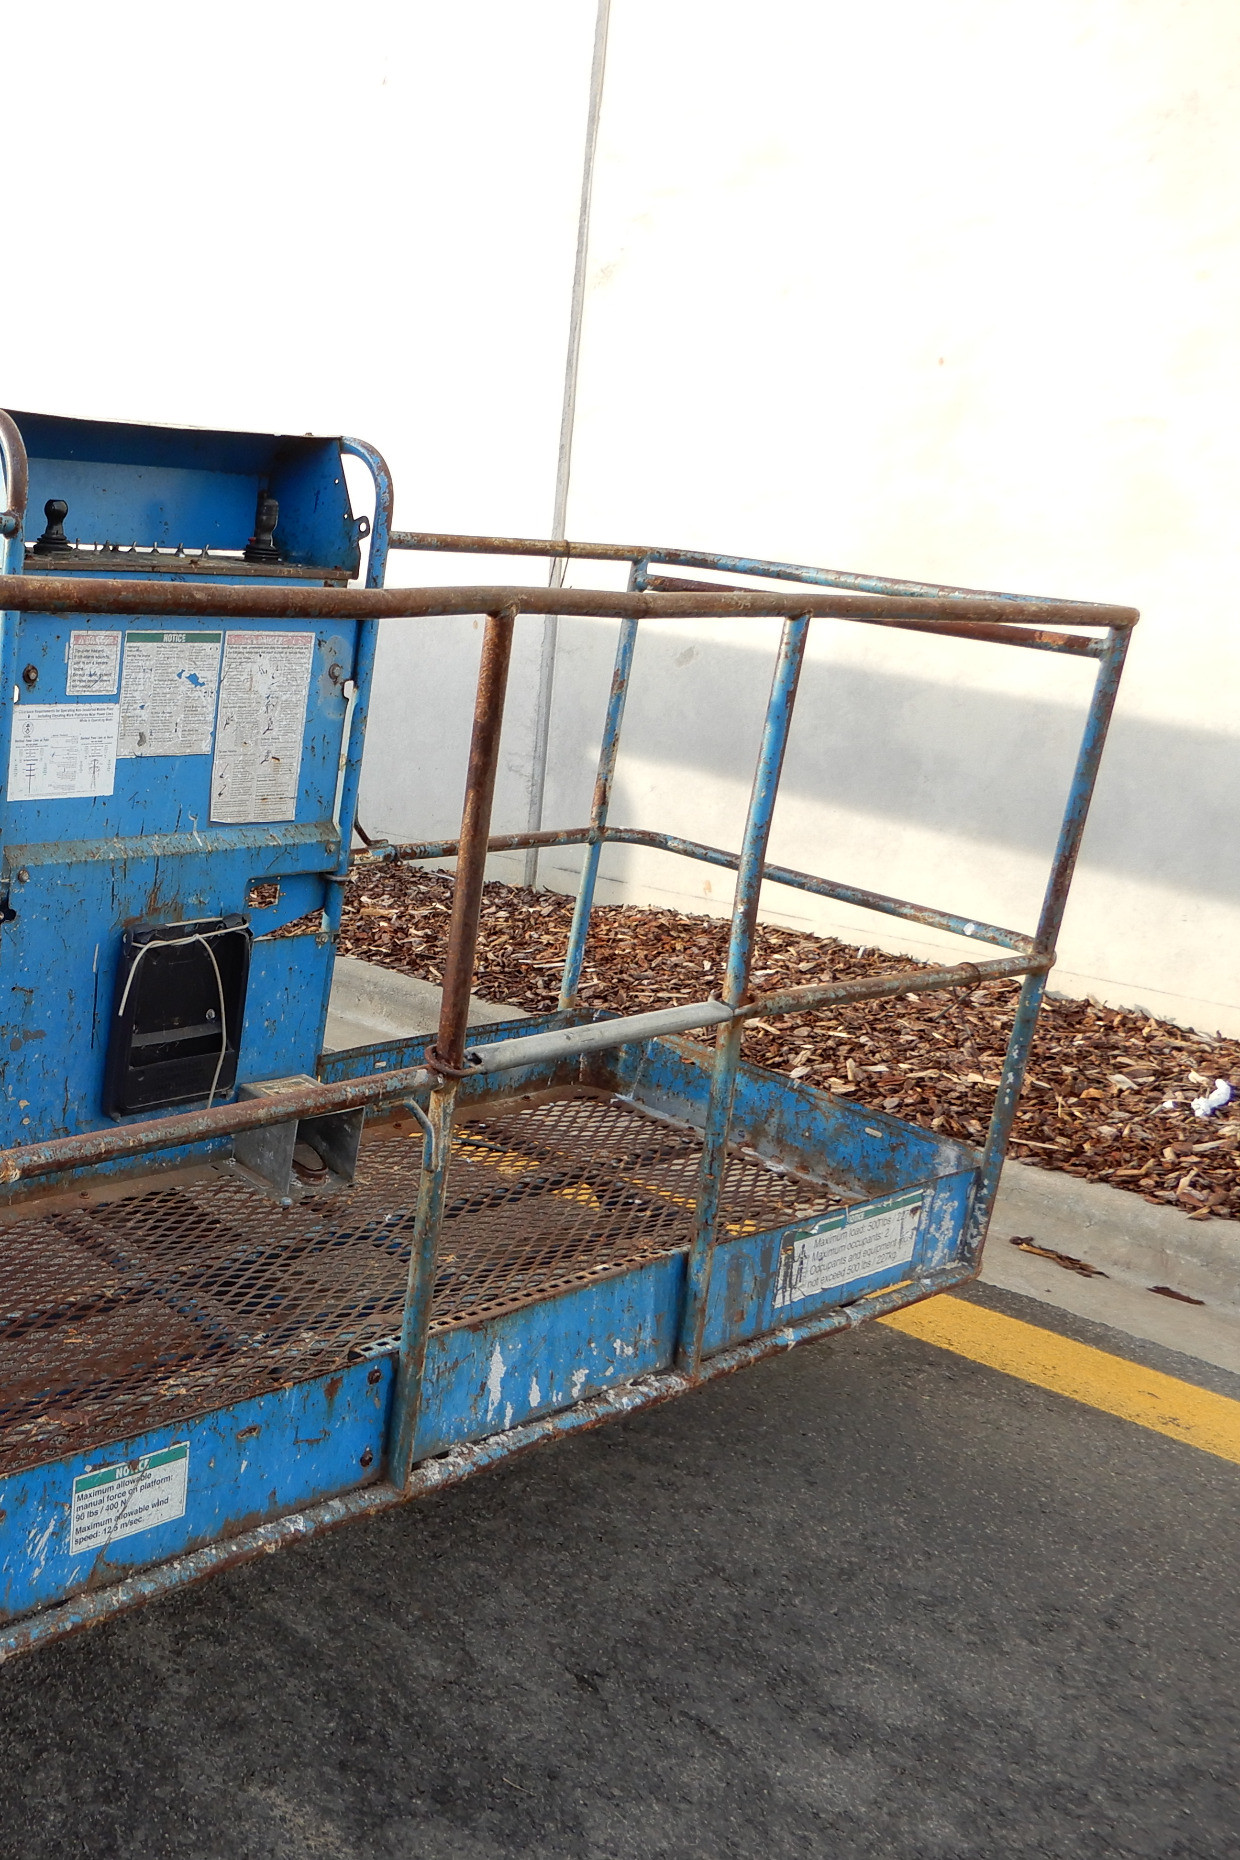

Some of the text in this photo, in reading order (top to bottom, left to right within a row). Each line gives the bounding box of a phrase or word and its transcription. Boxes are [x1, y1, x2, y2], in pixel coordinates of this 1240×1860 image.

[163, 633, 186, 643] NOTICE
[812, 1244, 846, 1261] Maximum
[847, 1233, 882, 1250] occupants:
[884, 1229, 889, 1238] 2
[814, 1232, 848, 1249] Maximum
[810, 1256, 847, 1276] Occupants
[848, 1252, 861, 1263] and
[862, 1239, 897, 1259] equipment
[807, 1278, 820, 1288] not
[821, 1267, 846, 1284] exceed
[846, 1263, 860, 1275] 500
[76, 1474, 173, 1513] manual force on platform:
[77, 1473, 152, 1503] Maximum allowable
[75, 1512, 86, 1523] 90
[87, 1509, 99, 1519] lbs
[105, 1501, 119, 1512] 400
[75, 1496, 170, 1535] Maximum allowable wind
[74, 1530, 102, 1546] speed:
